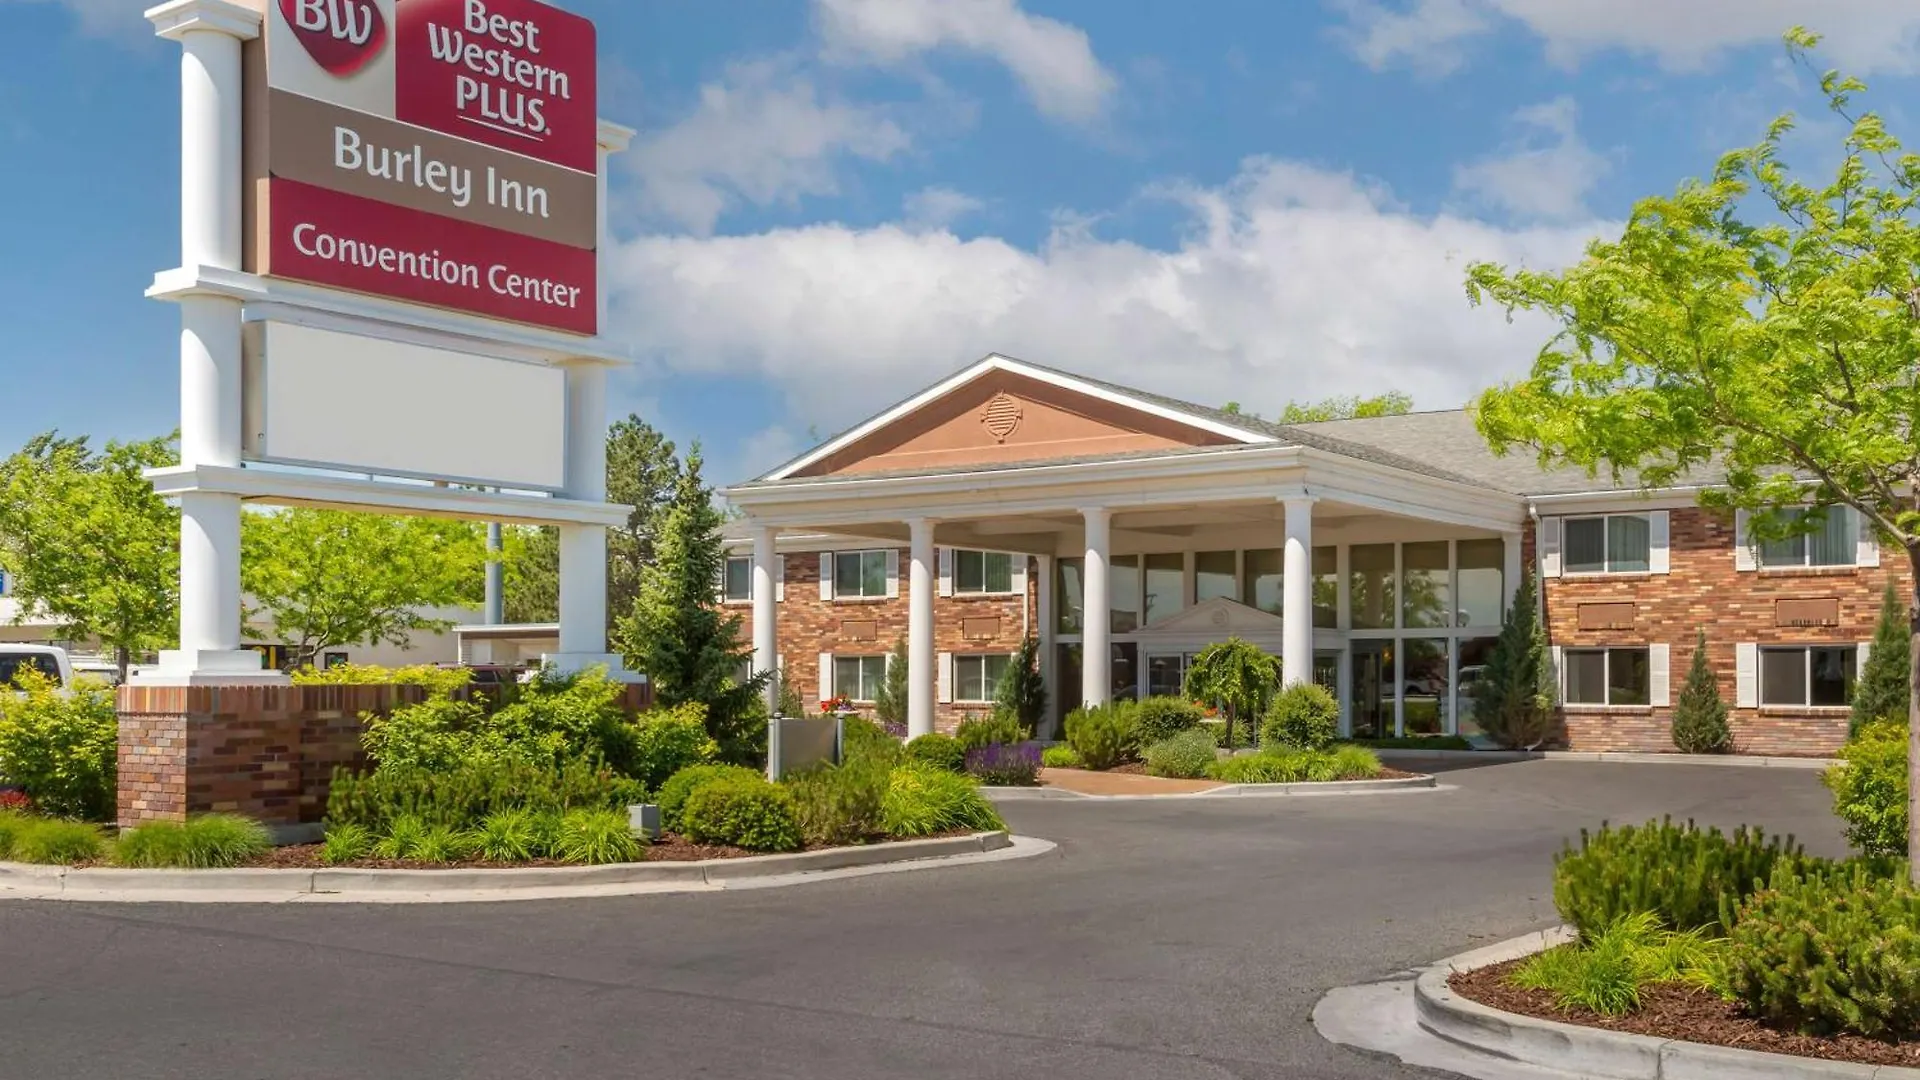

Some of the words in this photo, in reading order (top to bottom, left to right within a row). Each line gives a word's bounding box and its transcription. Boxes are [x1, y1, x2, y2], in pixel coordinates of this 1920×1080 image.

[295, 0, 371, 45] BW
[464, 0, 540, 54] Best
[428, 23, 571, 99] Western
[334, 126, 471, 208] Burley
[487, 167, 549, 218] Inn
[293, 223, 479, 289] Convention
[488, 265, 581, 308] Center
